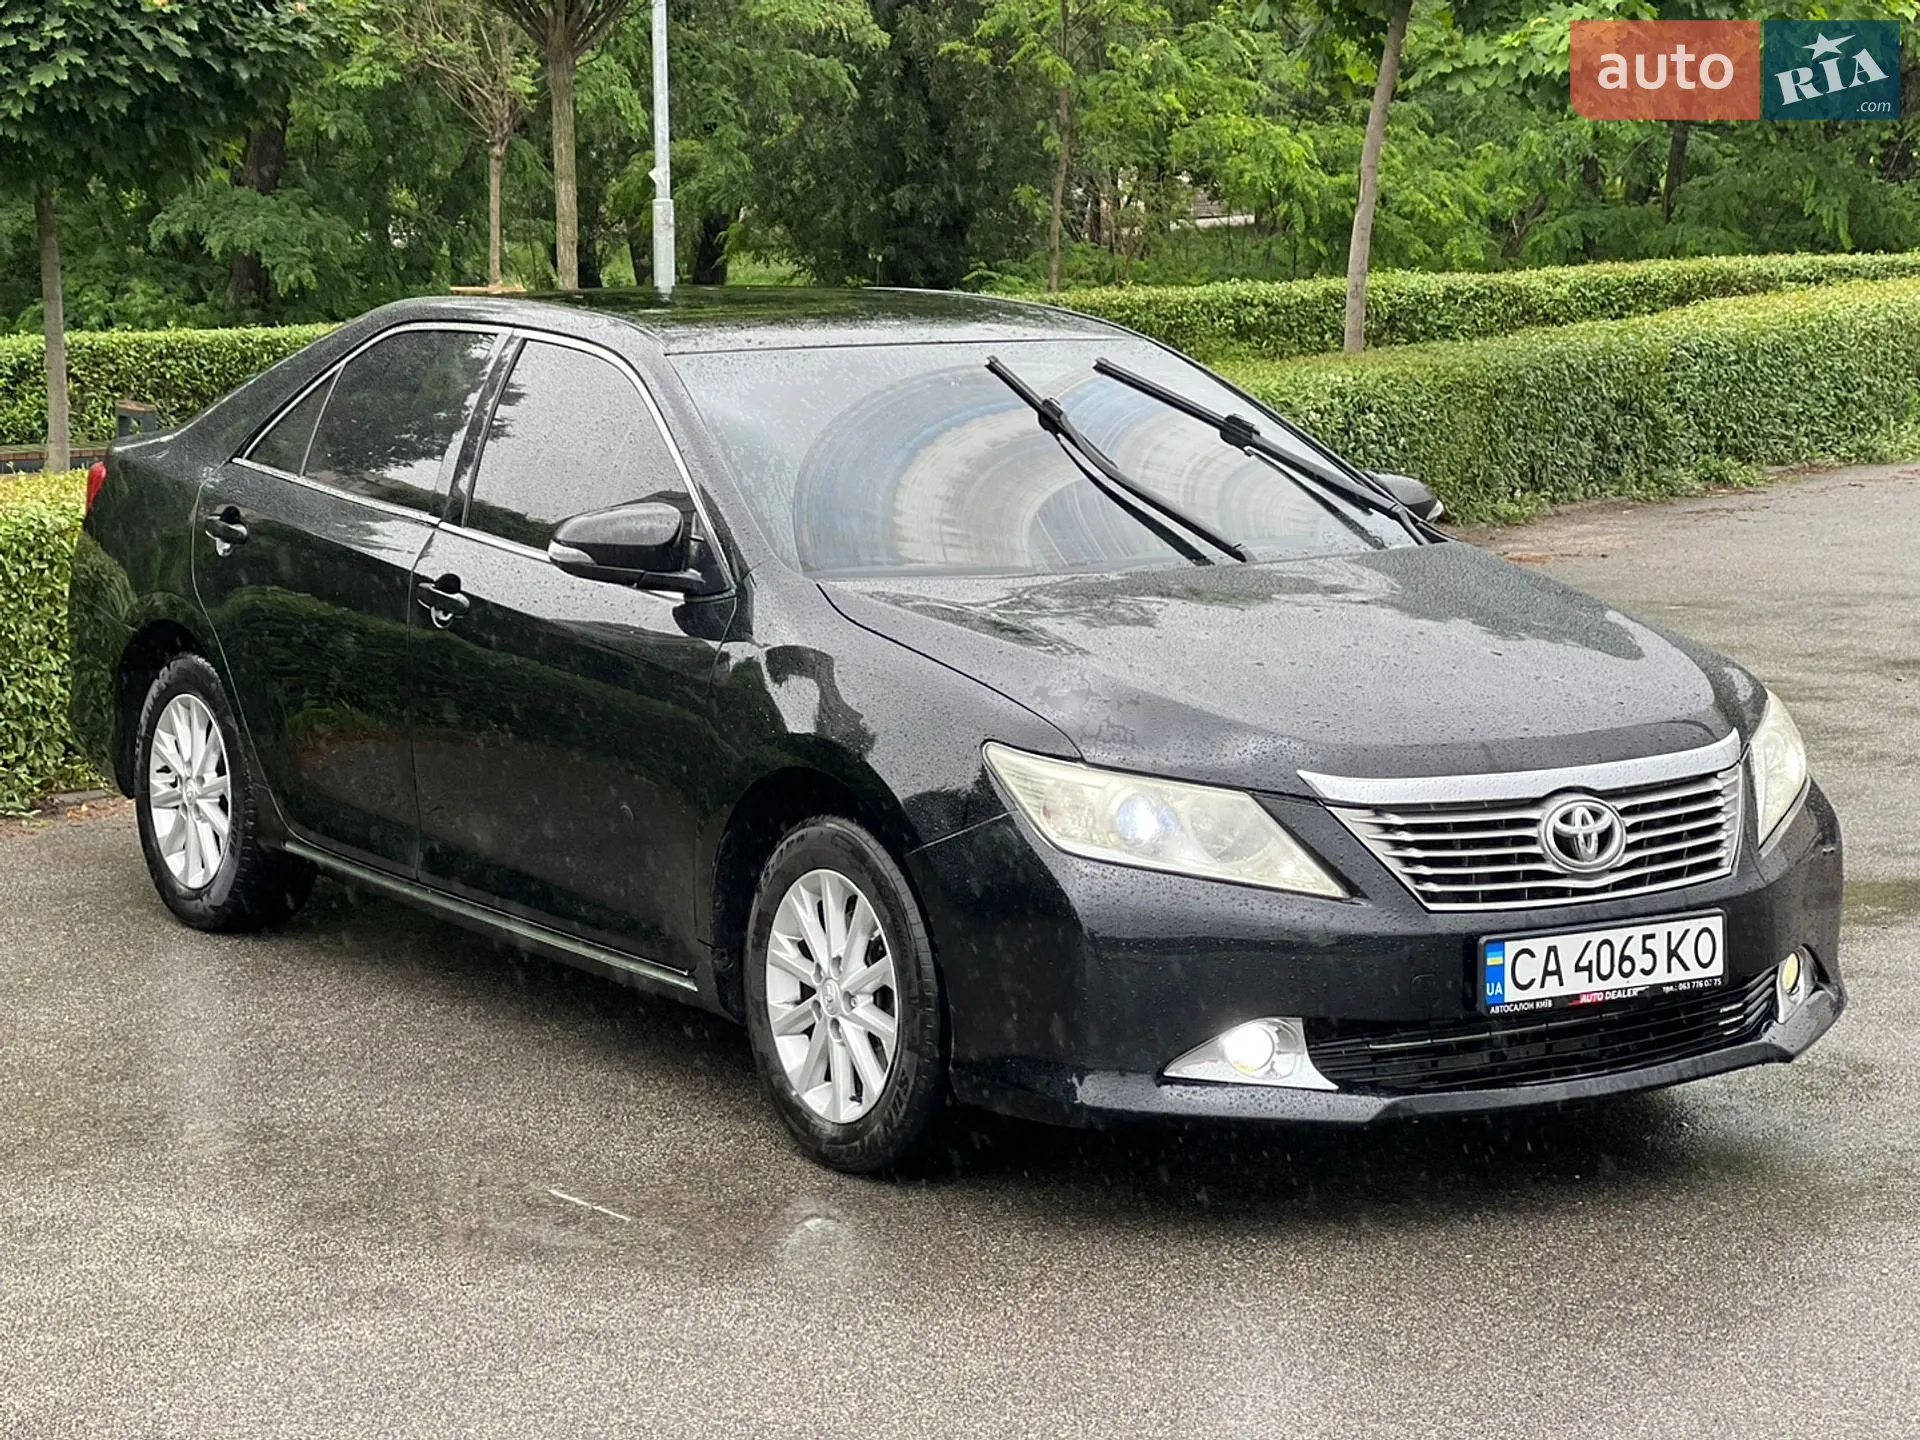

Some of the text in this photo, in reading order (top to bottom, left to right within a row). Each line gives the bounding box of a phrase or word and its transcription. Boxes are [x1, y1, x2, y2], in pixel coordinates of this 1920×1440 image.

[1510, 926, 1717, 991] CA 4065 KO
[1486, 982, 1503, 996] UA
[1579, 987, 1639, 1004] AUTO DEALER
[1489, 999, 1553, 1015] АВТОСАЛОН КИЇВ
